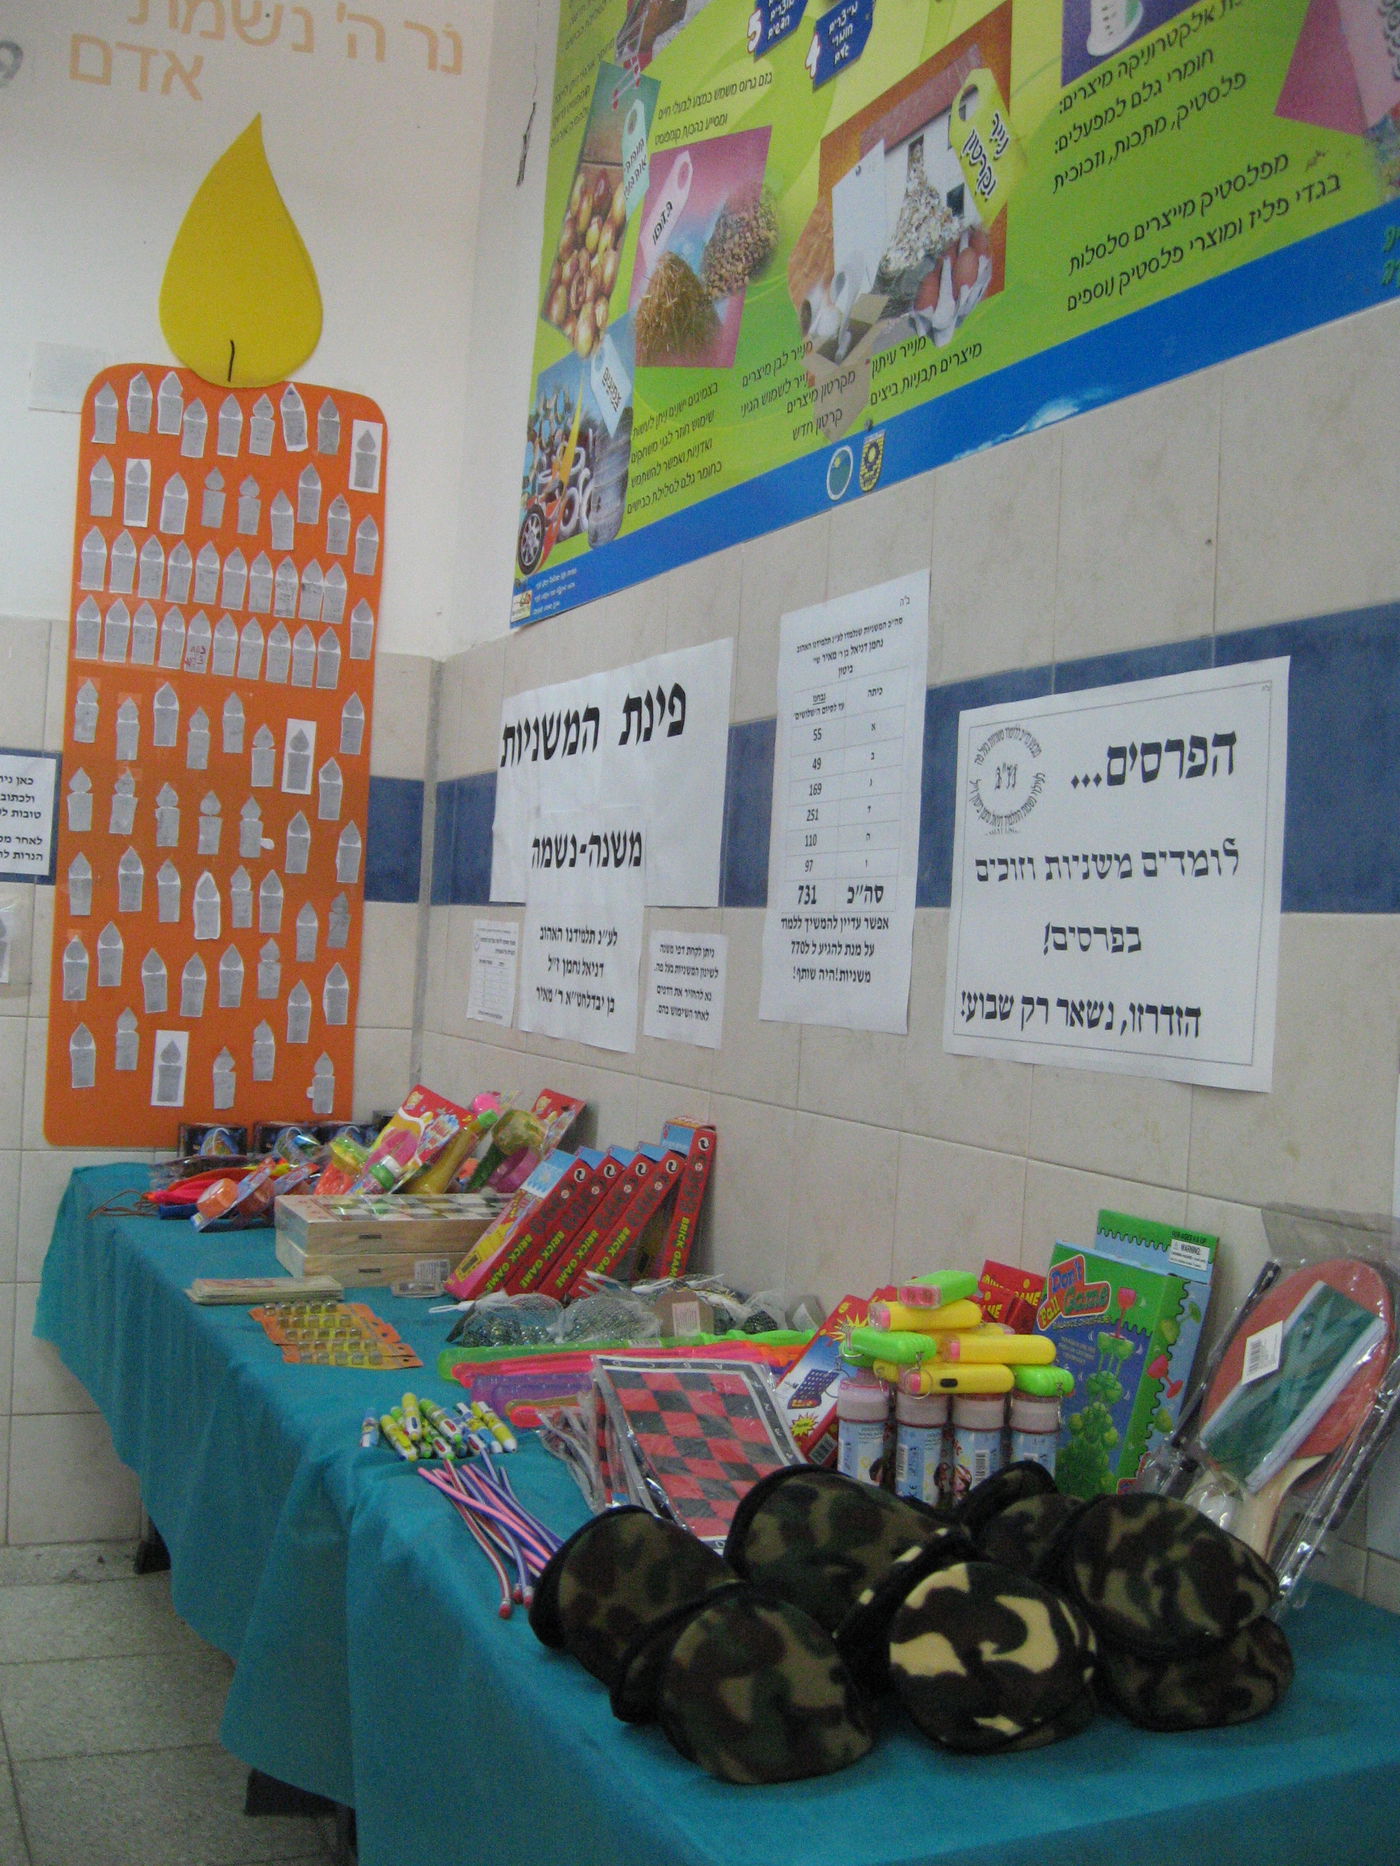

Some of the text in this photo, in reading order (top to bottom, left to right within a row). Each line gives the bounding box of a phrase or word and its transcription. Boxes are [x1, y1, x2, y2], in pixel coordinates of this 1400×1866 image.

[746, 8, 762, 54] 5
[403, 20, 463, 75] נר
[1059, 6, 1215, 114] אלקטרוניקה מיצרים:
[69, 32, 204, 100] אדם
[1055, 48, 1214, 154] חומרי גלם למפעלים:
[1053, 72, 1247, 194] פלסטיק, מתכות, וזכוכית
[1295, 173, 1342, 204] בגדי
[1068, 153, 1289, 276] מפלסטיק מייצרים סלסלות
[1248, 197, 1290, 230] פליז
[1189, 218, 1243, 252] ומוצרי
[1118, 245, 1184, 297] פלסטיק
[773, 351, 789, 376] לבן
[870, 342, 983, 406] מיצרים תבניות ביצים
[871, 349, 897, 380] עיתון
[820, 370, 856, 404] מקרטון
[793, 407, 843, 441] קרטון חדש
[500, 682, 687, 768] פינת המשניות
[812, 722, 876, 741] א 55
[812, 757, 821, 770] 49
[1070, 731, 1238, 790] הפרסים...
[16, 776, 34, 786] כאן
[809, 783, 822, 797] 169
[11, 809, 41, 819] טובות
[806, 808, 819, 822] 251
[13, 851, 43, 862] הנרות
[15, 835, 43, 846] לאחר
[531, 829, 643, 870] משנה-נשמה
[805, 834, 817, 847] 110
[804, 859, 813, 873] 97
[974, 838, 1240, 882] לומדים משניות וזוכים
[798, 884, 817, 905] 731
[804, 914, 838, 933] להמשיך
[840, 917, 862, 933] עדיין
[863, 917, 889, 930] אפשר
[1043, 921, 1142, 956] בפרסים!
[818, 940, 843, 956] להגיע
[844, 943, 862, 956] מנת
[864, 941, 875, 957] על
[562, 957, 580, 977] נחמן
[582, 957, 604, 977] דניאל
[536, 986, 553, 1003] מאיר
[607, 996, 615, 1017] בן
[960, 990, 1202, 1039] הזדרזו, נשאר רק שבוע!
[486, 1233, 533, 1291] BRICK GAME
[519, 1230, 566, 1289] BRICK GAME
[555, 1229, 600, 1289] BRICK GAME
[594, 1226, 632, 1275] BRICK GA
[669, 1216, 690, 1278] BRICK GAM
